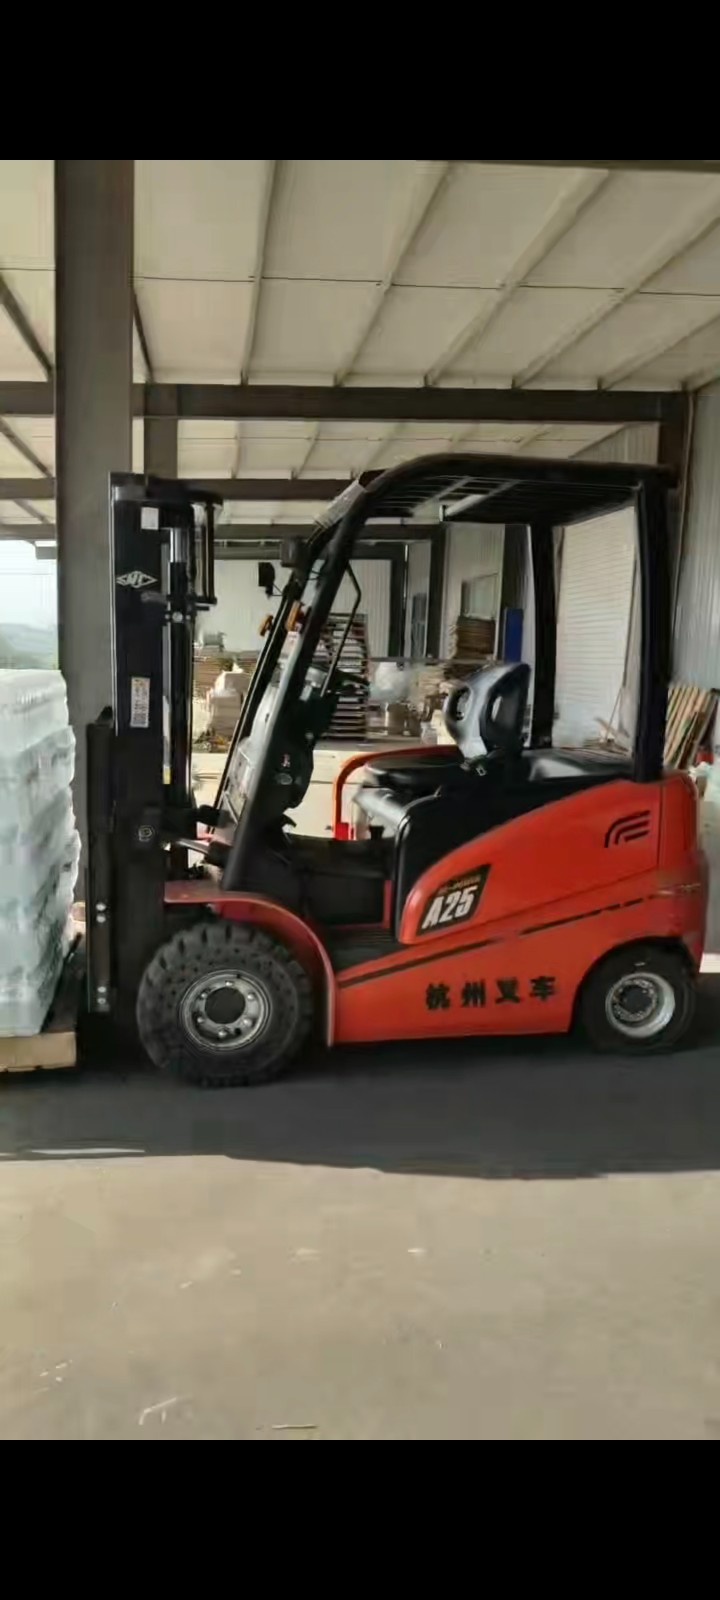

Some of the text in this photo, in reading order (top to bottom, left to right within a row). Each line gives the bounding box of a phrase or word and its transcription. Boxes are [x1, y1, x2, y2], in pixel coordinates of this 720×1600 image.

[421, 885, 478, 929] A25
[426, 976, 556, 1011] 杭州叉车
